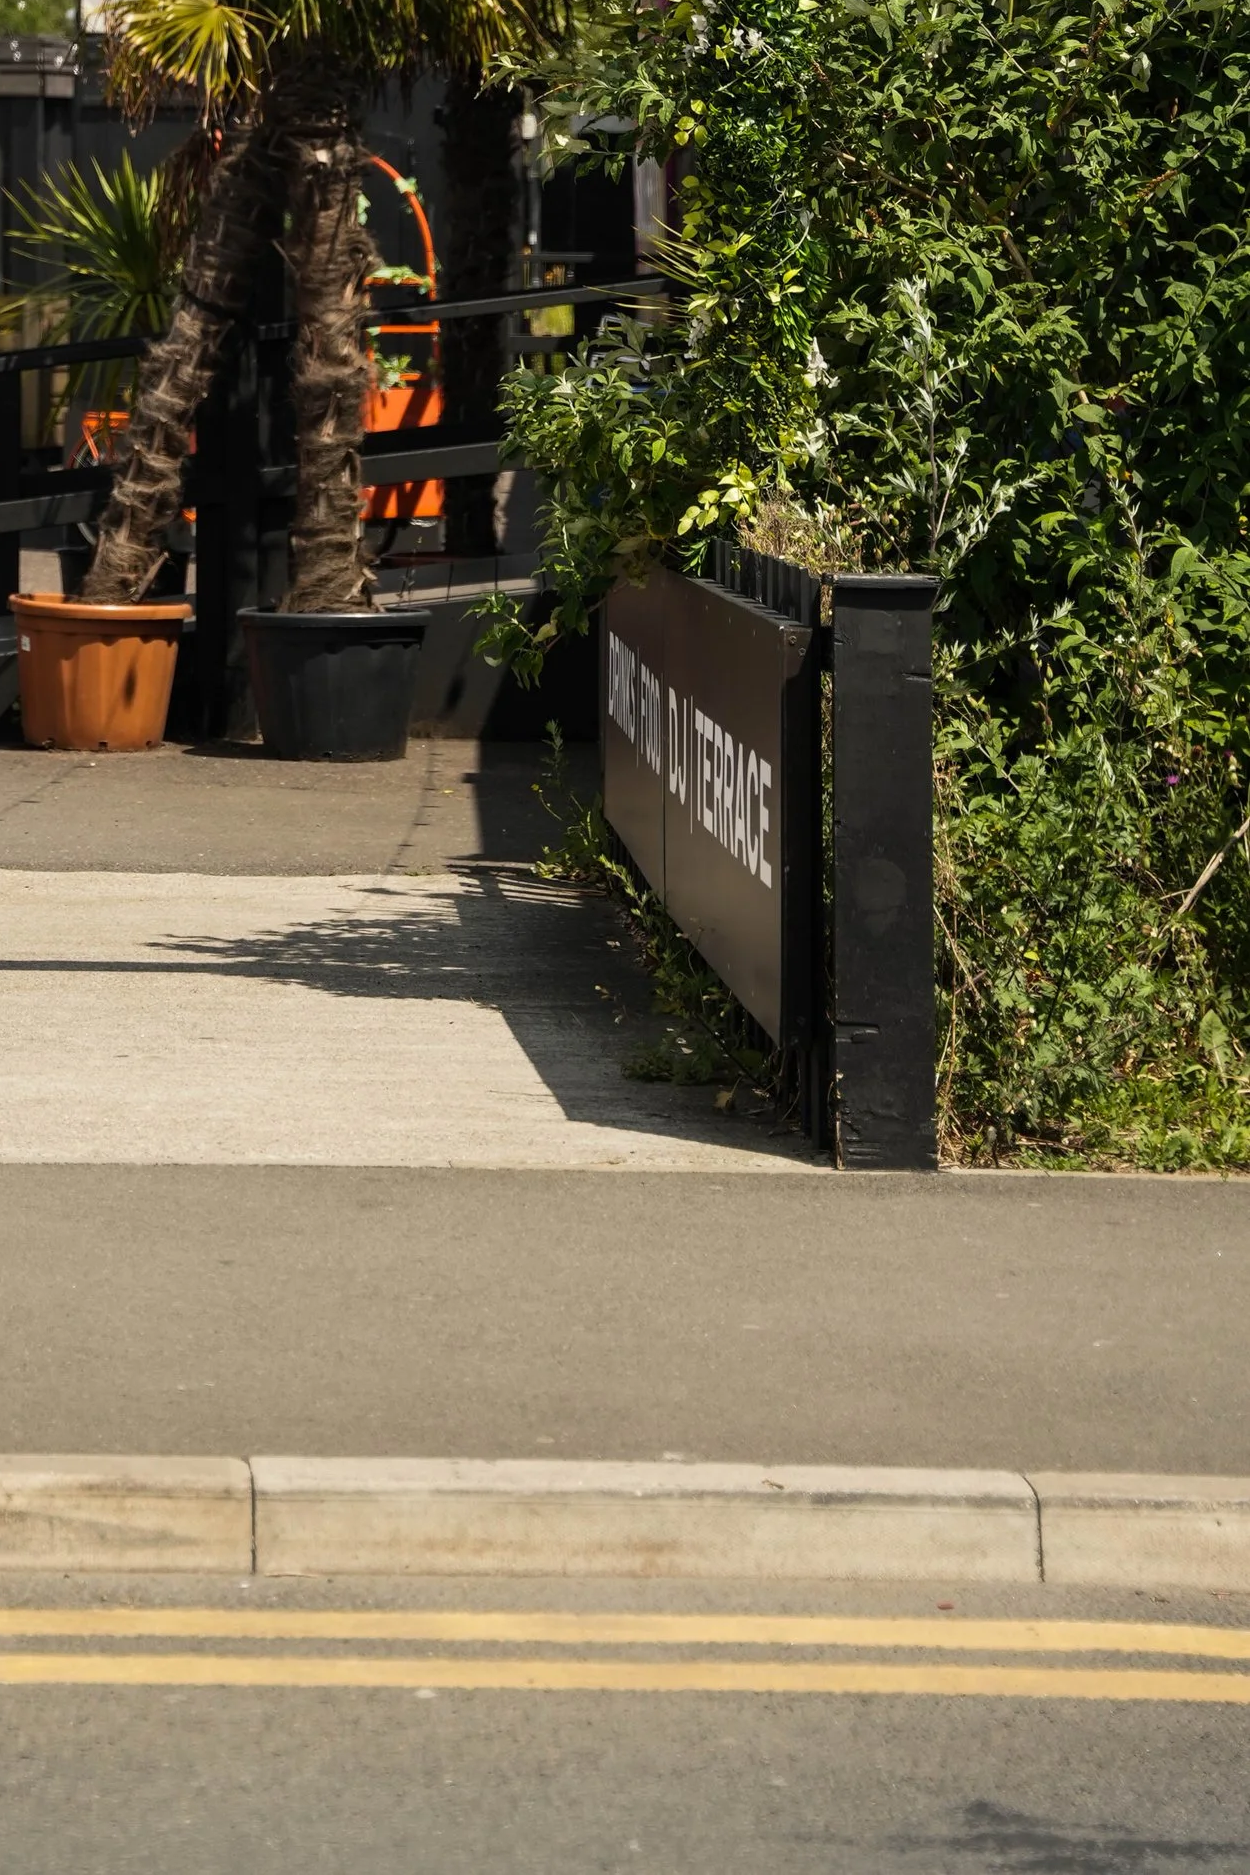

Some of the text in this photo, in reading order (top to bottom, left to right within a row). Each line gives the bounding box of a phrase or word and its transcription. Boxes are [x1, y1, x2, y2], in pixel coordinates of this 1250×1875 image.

[608, 630, 772, 890] DRINKS FOOD DJ TERRACE
